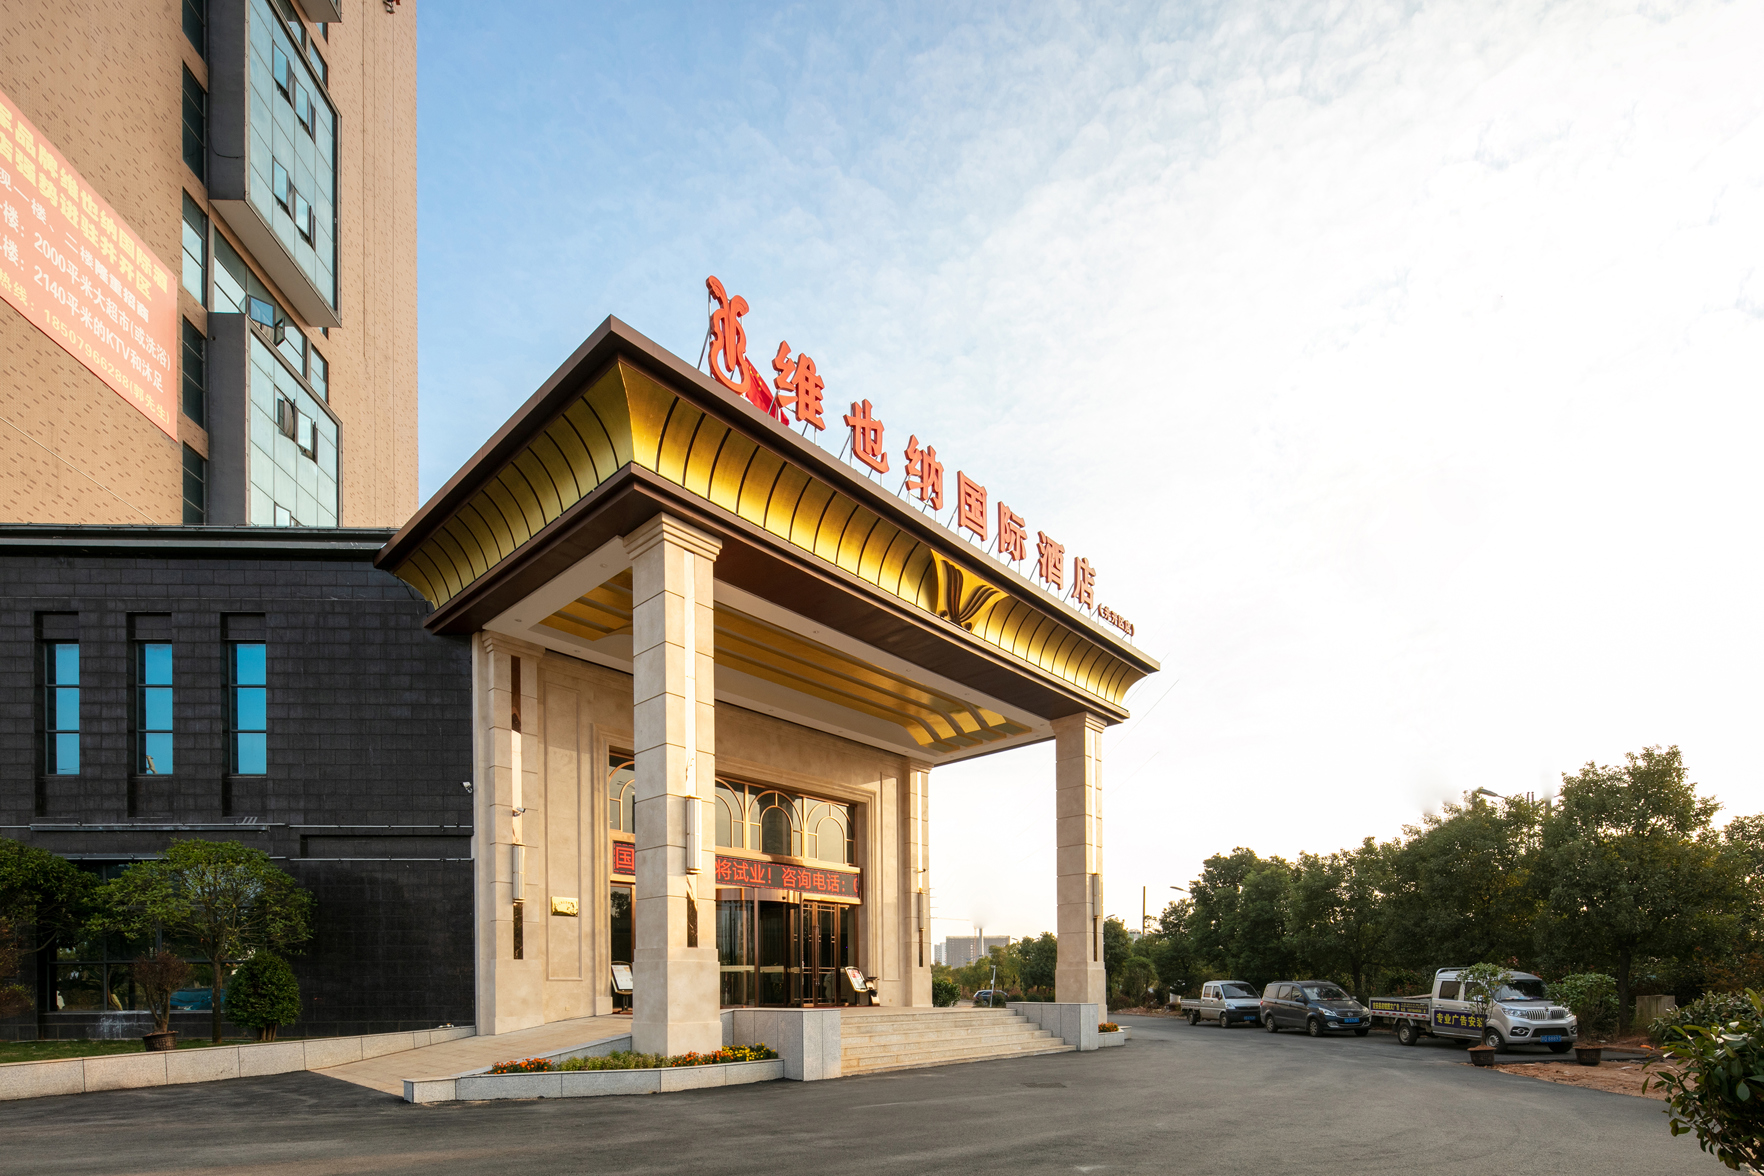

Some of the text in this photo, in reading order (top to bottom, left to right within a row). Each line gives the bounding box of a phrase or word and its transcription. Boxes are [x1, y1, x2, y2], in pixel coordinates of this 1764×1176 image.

[772, 340, 1097, 610] 维也纳国际酒店
[615, 846, 635, 871] 国
